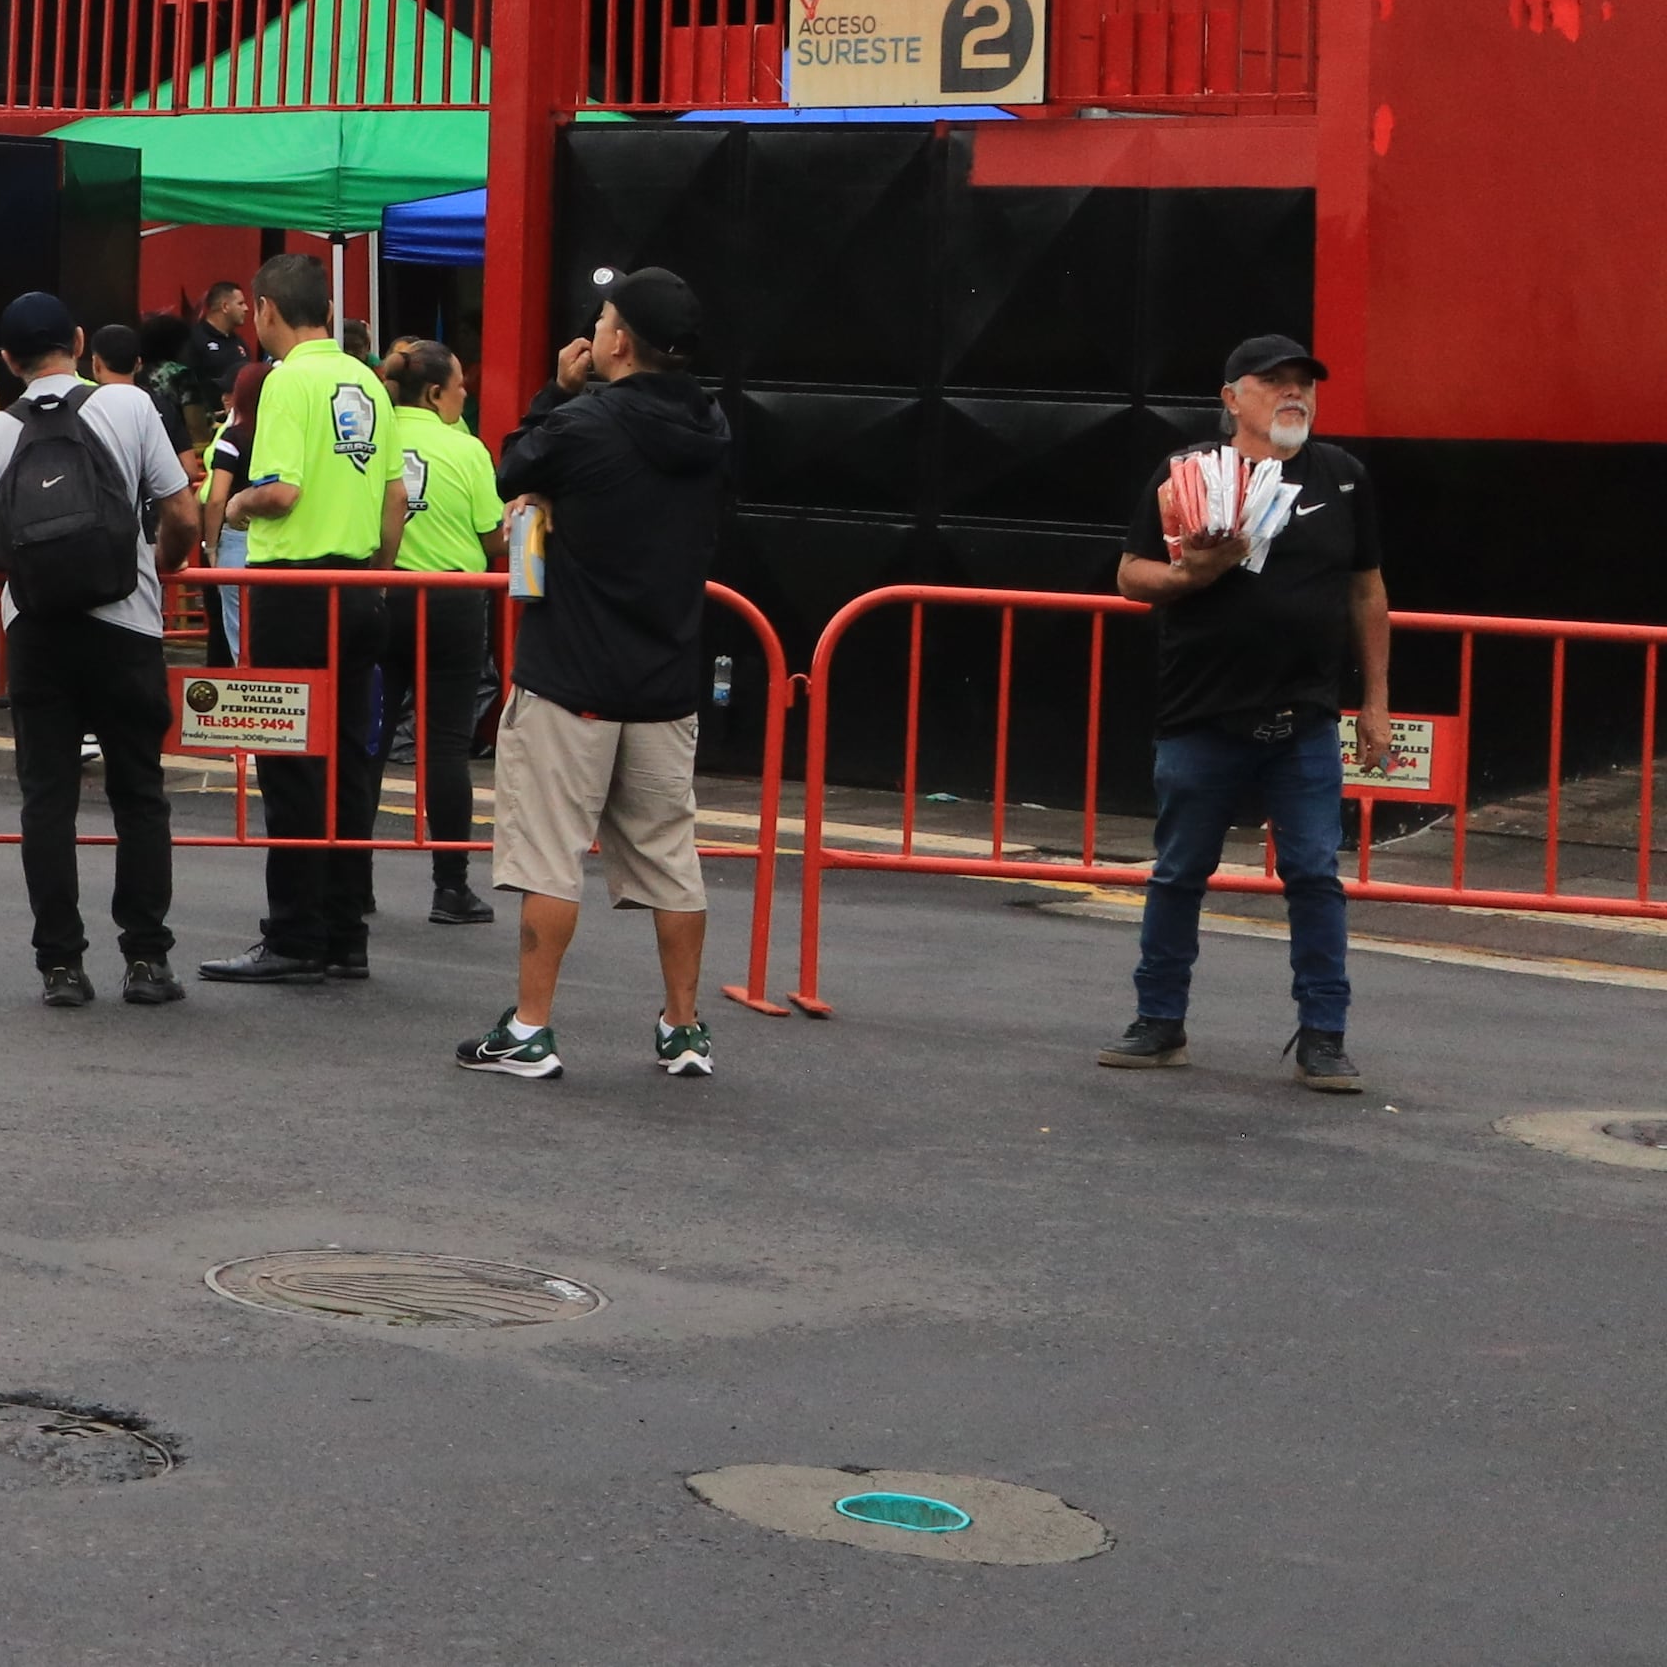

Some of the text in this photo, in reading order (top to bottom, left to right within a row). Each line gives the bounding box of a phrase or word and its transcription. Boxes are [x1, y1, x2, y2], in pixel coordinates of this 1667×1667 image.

[798, 15, 877, 36] ACCESO
[797, 36, 922, 66] SURESTE
[227, 683, 299, 694] ALQUILER DE
[242, 695, 283, 704] VALLAS
[221, 705, 306, 716] PERIMETRALES
[196, 714, 295, 731] TEL:8345-9494
[1408, 724, 1424, 732] DE
